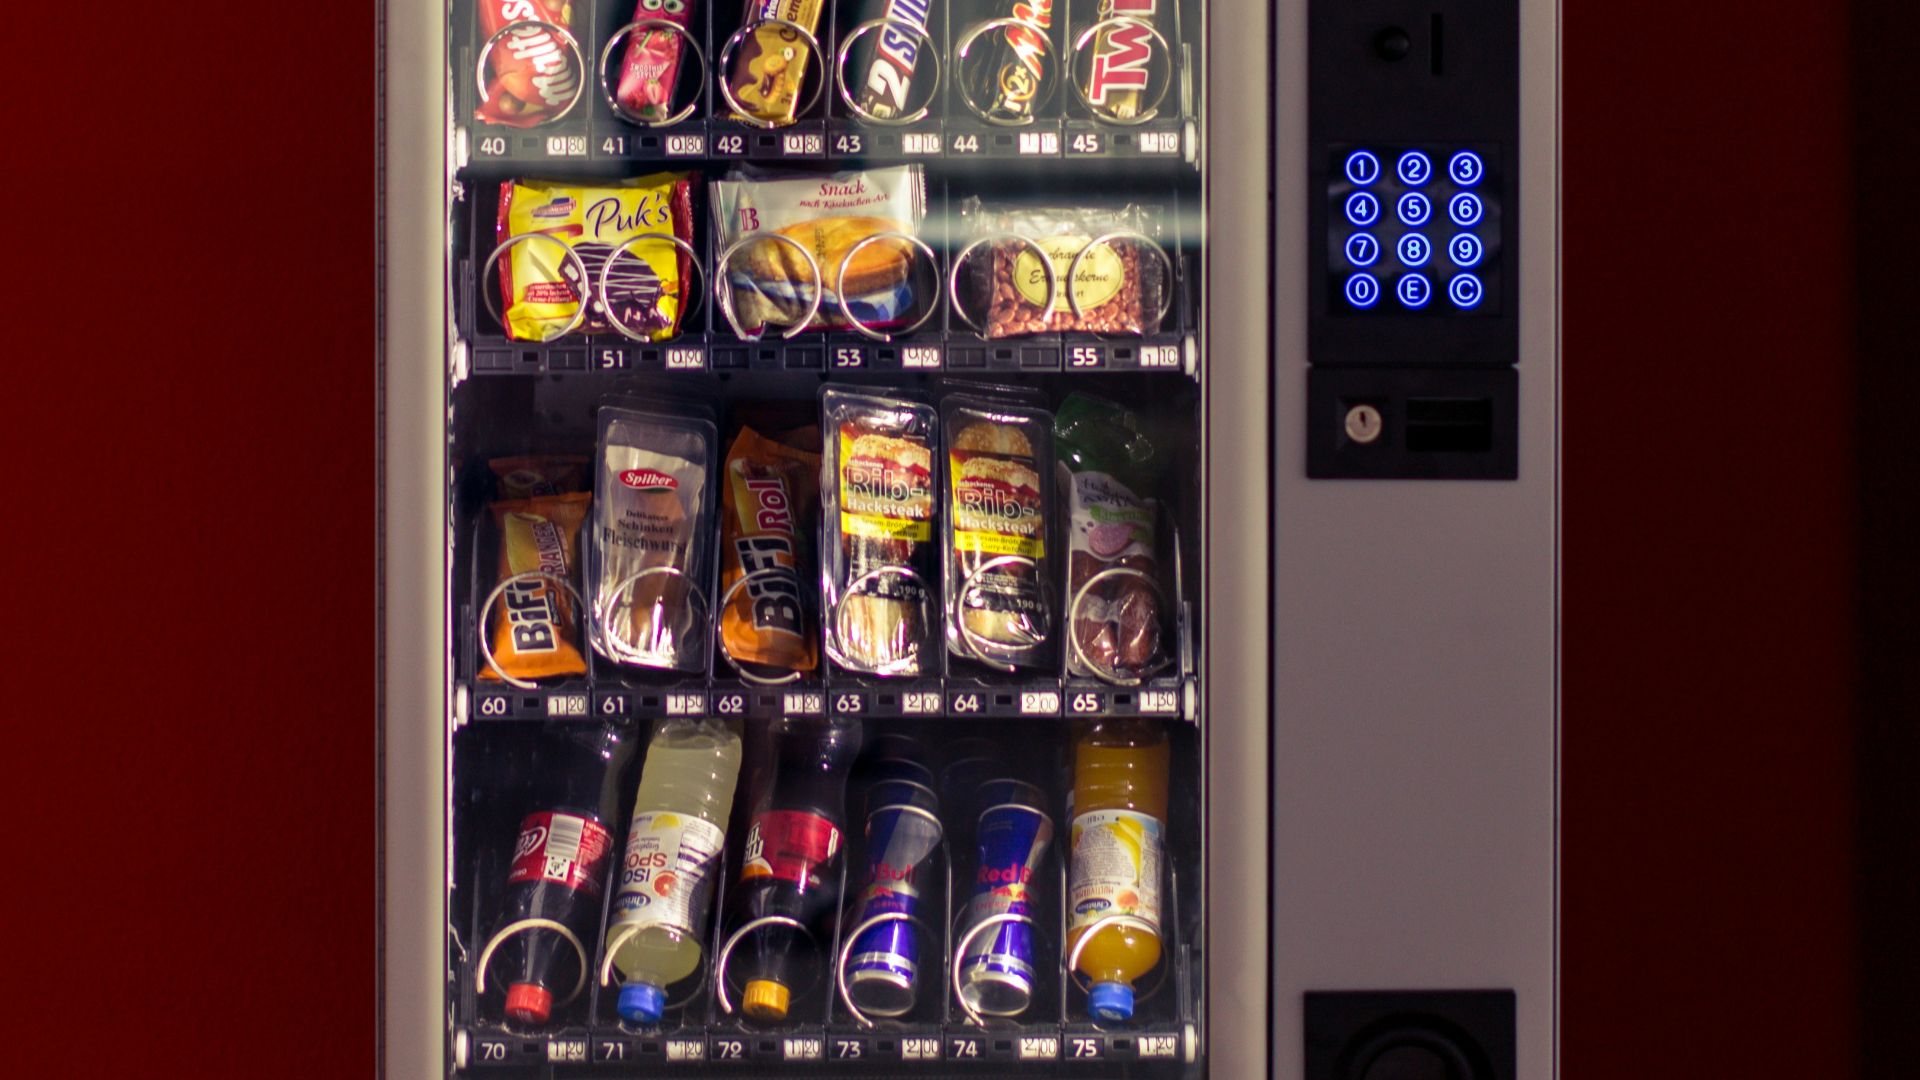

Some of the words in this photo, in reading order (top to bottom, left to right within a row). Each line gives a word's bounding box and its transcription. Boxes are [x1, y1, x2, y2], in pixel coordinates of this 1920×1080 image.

[481, 137, 505, 154] 40
[602, 137, 623, 154] 41
[718, 136, 742, 153] 42
[836, 136, 861, 153] 43
[953, 135, 978, 152] 44
[1073, 135, 1098, 152] 45
[1357, 159, 1366, 177] 1
[1407, 159, 1421, 178] 2
[1459, 159, 1473, 178] 3
[819, 179, 866, 196] Snack
[585, 194, 669, 238] Puk's
[1354, 199, 1367, 217] 4
[1407, 199, 1421, 218] 5
[1458, 199, 1473, 218] 6
[1355, 240, 1369, 258] 7
[1406, 240, 1420, 259] 8
[1458, 240, 1472, 259] 9
[1355, 280, 1368, 299] 0
[1406, 280, 1419, 300] E
[1456, 280, 1474, 300] C
[602, 350, 623, 368] 51
[837, 349, 861, 366] 53
[1073, 348, 1098, 366] 55
[625, 472, 674, 487] Spilker
[846, 466, 925, 503] Rib-
[847, 499, 925, 518] Hacksteak
[957, 487, 1036, 522] Rib-
[618, 519, 675, 535] Schinken
[960, 517, 1037, 536] Hacksteak
[503, 577, 558, 655] BiFi
[481, 697, 506, 714] 60
[602, 696, 623, 713] 61
[718, 696, 743, 713] 62
[836, 695, 861, 712] 63
[954, 694, 979, 712] 64
[1073, 694, 1098, 712] 65
[481, 1043, 505, 1060] 70
[602, 1043, 623, 1059] 71
[718, 1041, 742, 1058] 72
[837, 1041, 861, 1058] 73
[954, 1040, 978, 1057] 74
[1073, 1039, 1097, 1057] 75
